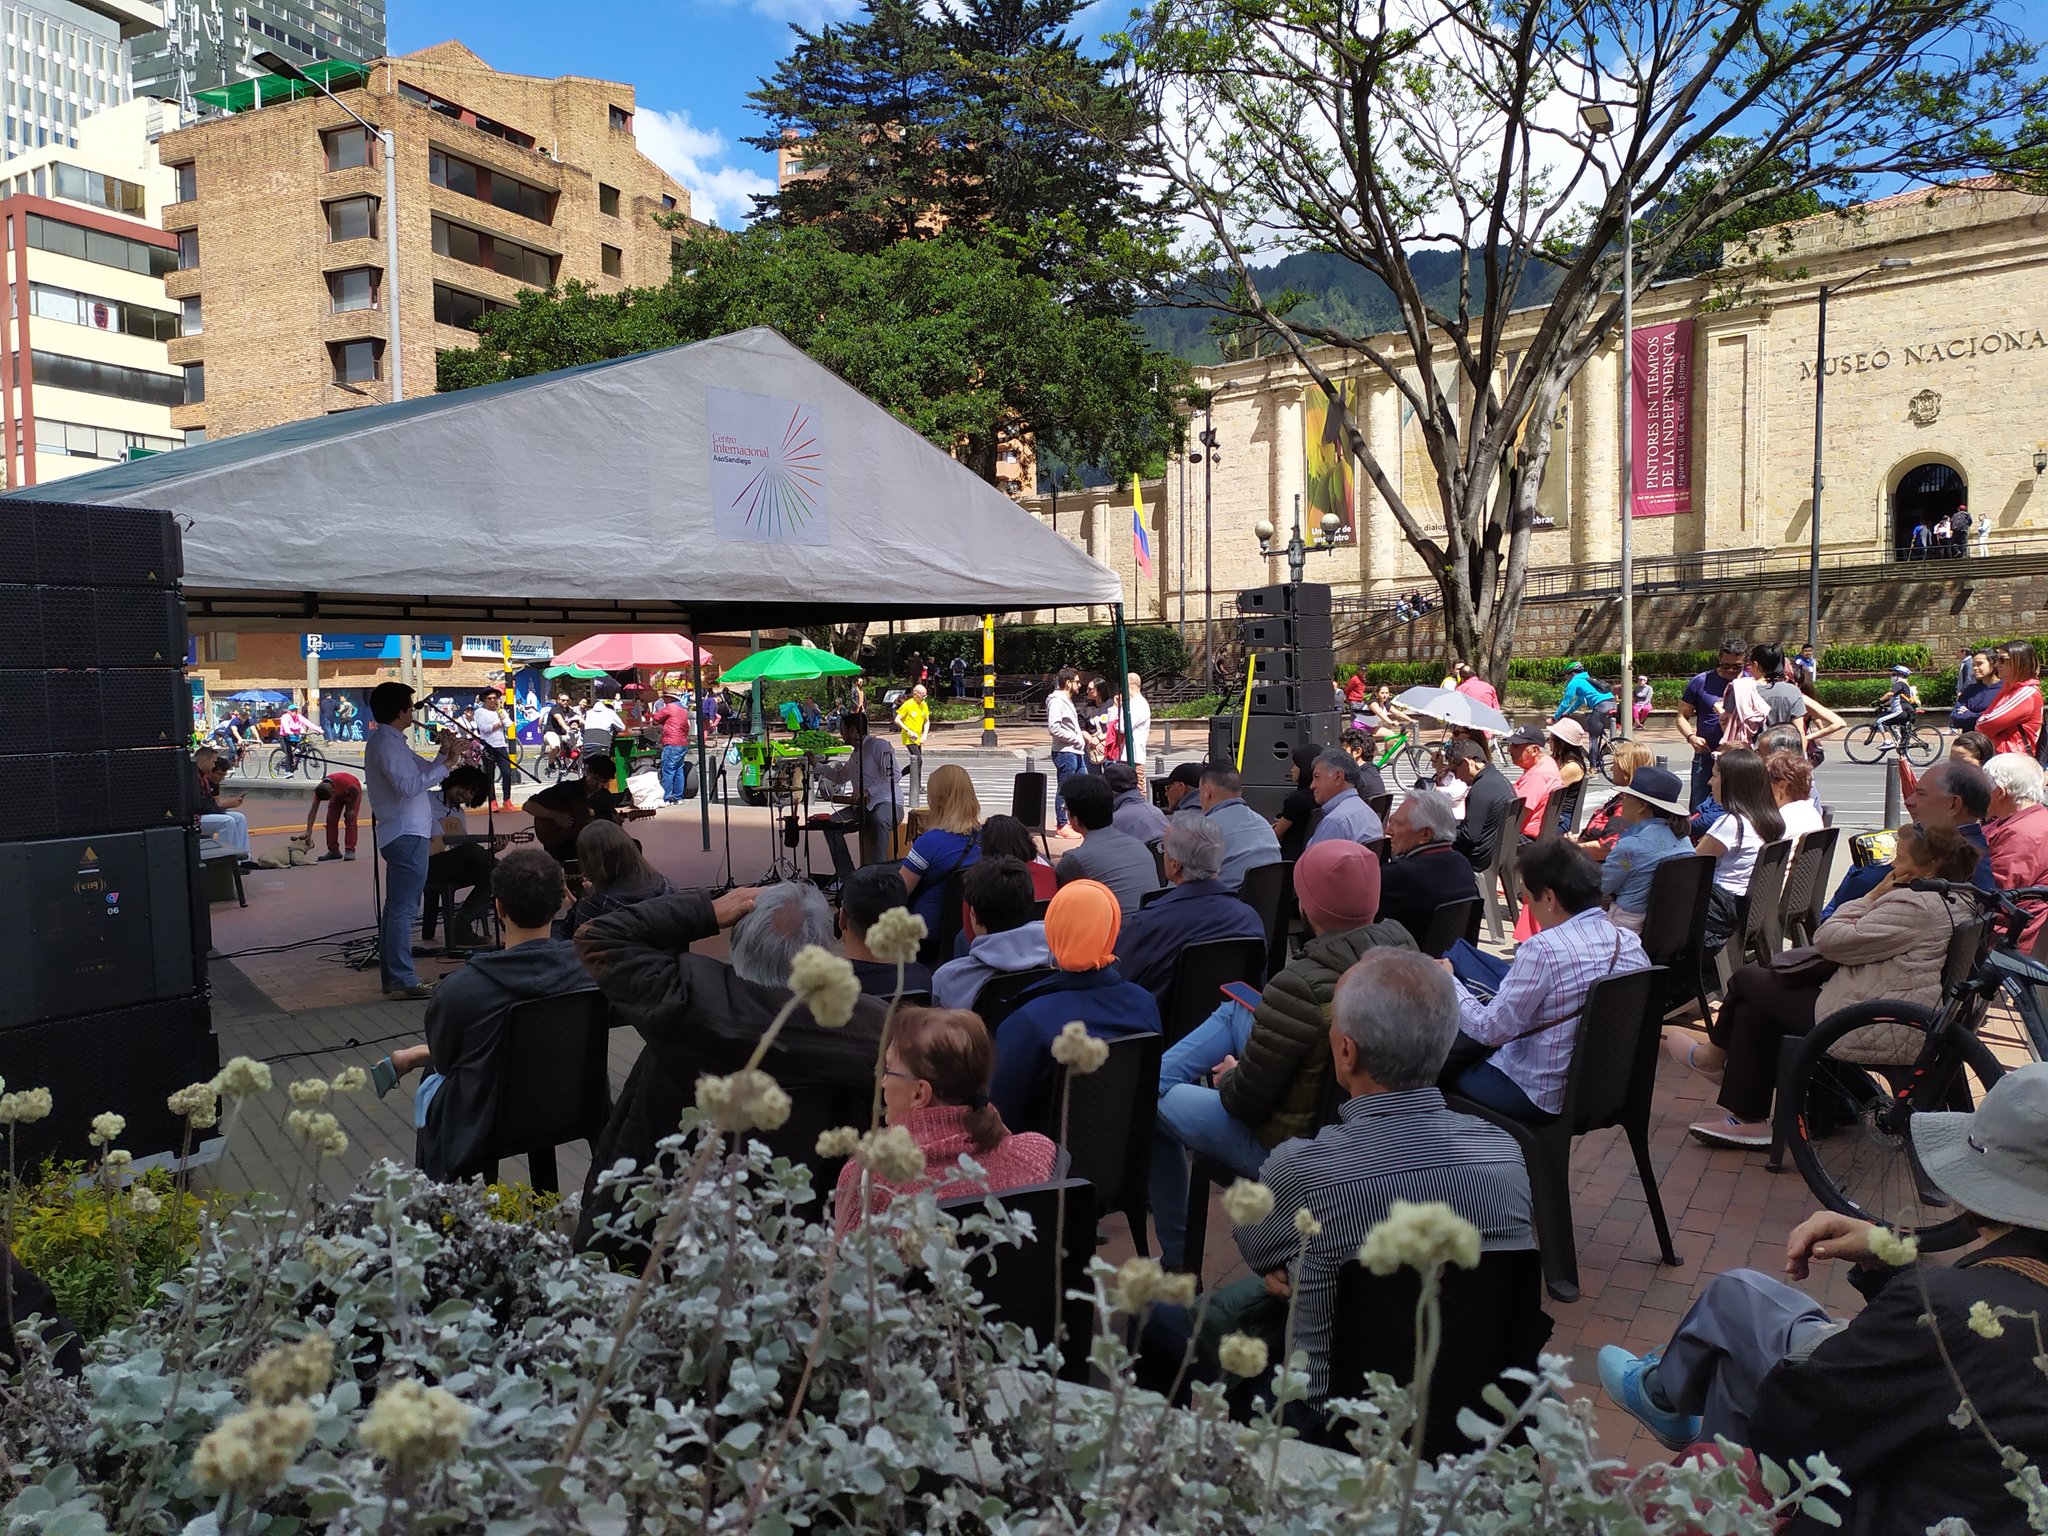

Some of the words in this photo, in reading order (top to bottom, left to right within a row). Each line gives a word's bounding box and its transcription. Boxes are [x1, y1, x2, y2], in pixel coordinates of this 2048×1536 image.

[1647, 336, 1659, 398] TIEMPOS
[1678, 354, 1687, 389] Espinosa
[1800, 349, 1891, 381] MUSEO
[1662, 331, 1675, 446] INDEPENDENCIA
[1647, 400, 1659, 420] EN
[1677, 396, 1686, 421] Castro
[1679, 423, 1685, 432] de
[712, 432, 737, 443] Centro
[712, 441, 769, 458] Internacional
[1646, 422, 1659, 489] PINTORES
[1662, 449, 1674, 466] LA
[712, 455, 752, 466] AsoSandiego
[1662, 469, 1674, 488] DE
[1677, 453, 1685, 487] Figueroa
[1423, 523, 1448, 532] dialog
[1532, 515, 1555, 525] ebrar
[1311, 527, 1323, 535] Un
[1342, 525, 1352, 533] de
[1313, 534, 1349, 543] encntro
[466, 637, 480, 651] FOTO
[482, 638, 486, 651] Y
[487, 638, 501, 652] ARTE
[107, 906, 120, 915] 06
